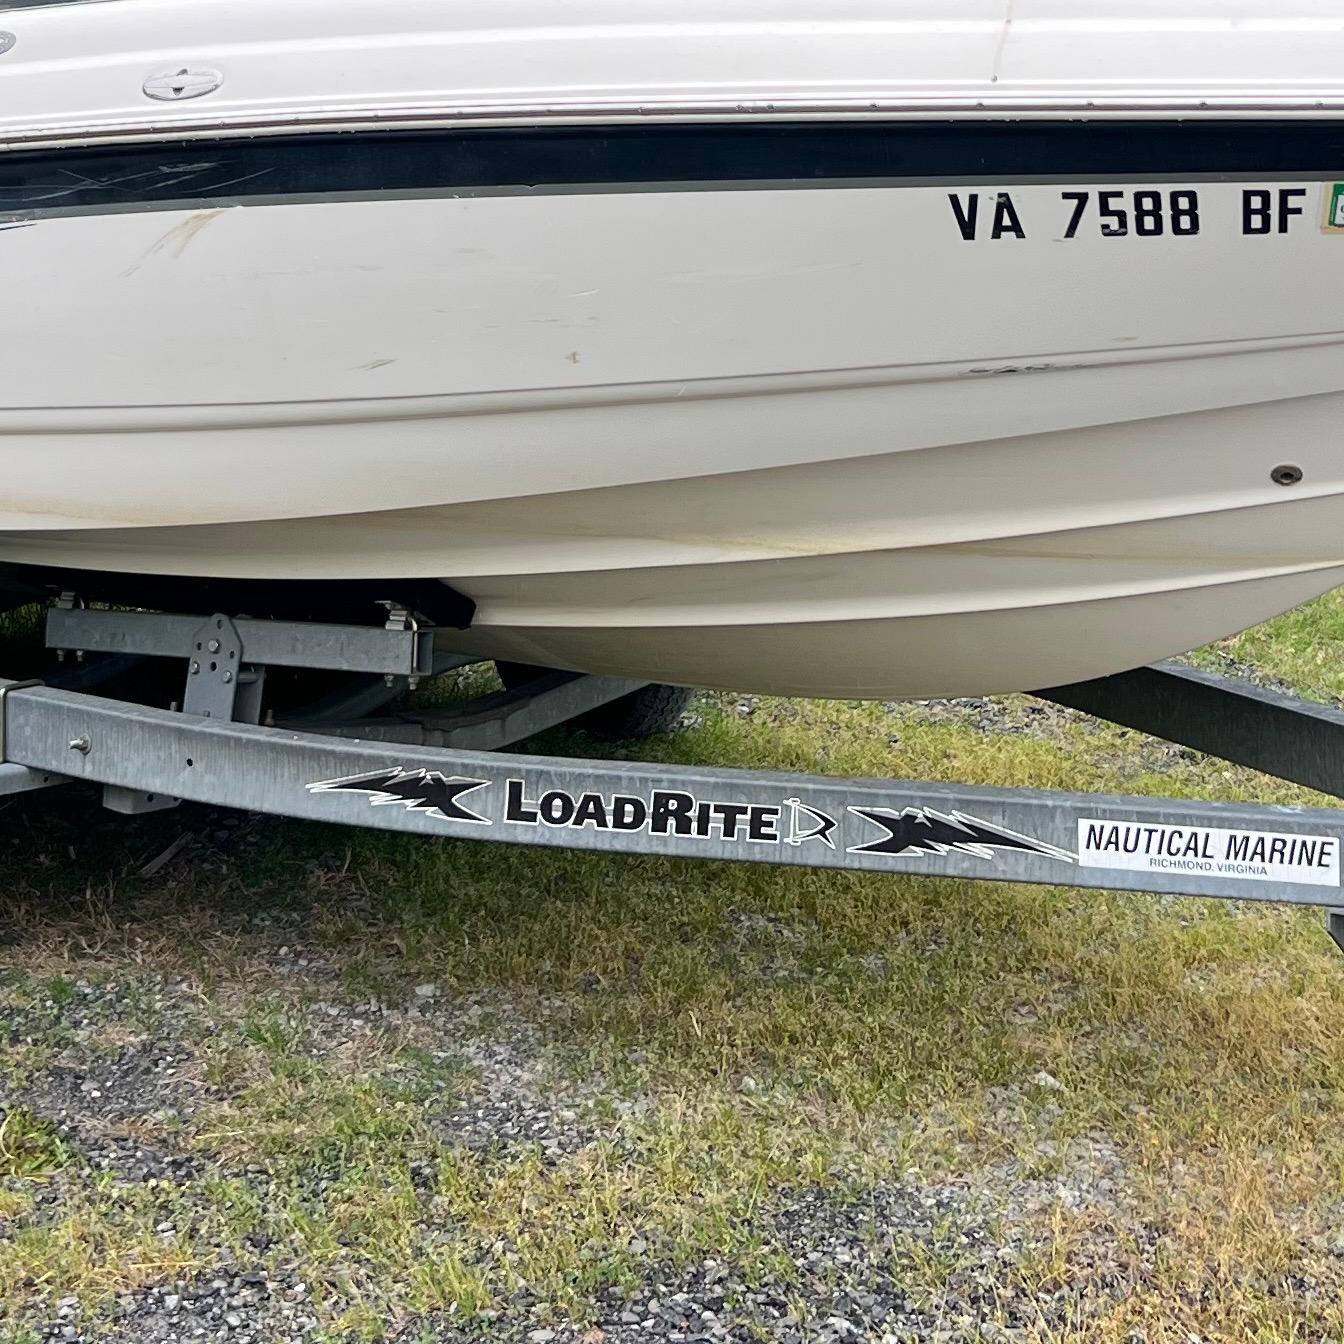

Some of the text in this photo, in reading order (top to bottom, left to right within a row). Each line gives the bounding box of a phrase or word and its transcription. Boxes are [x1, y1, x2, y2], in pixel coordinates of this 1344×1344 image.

[947, 188, 1307, 241] VA 7588 BF
[1085, 823, 1335, 869] NAUTICAL MARINE
[1217, 863, 1269, 876] VIRGINIA
